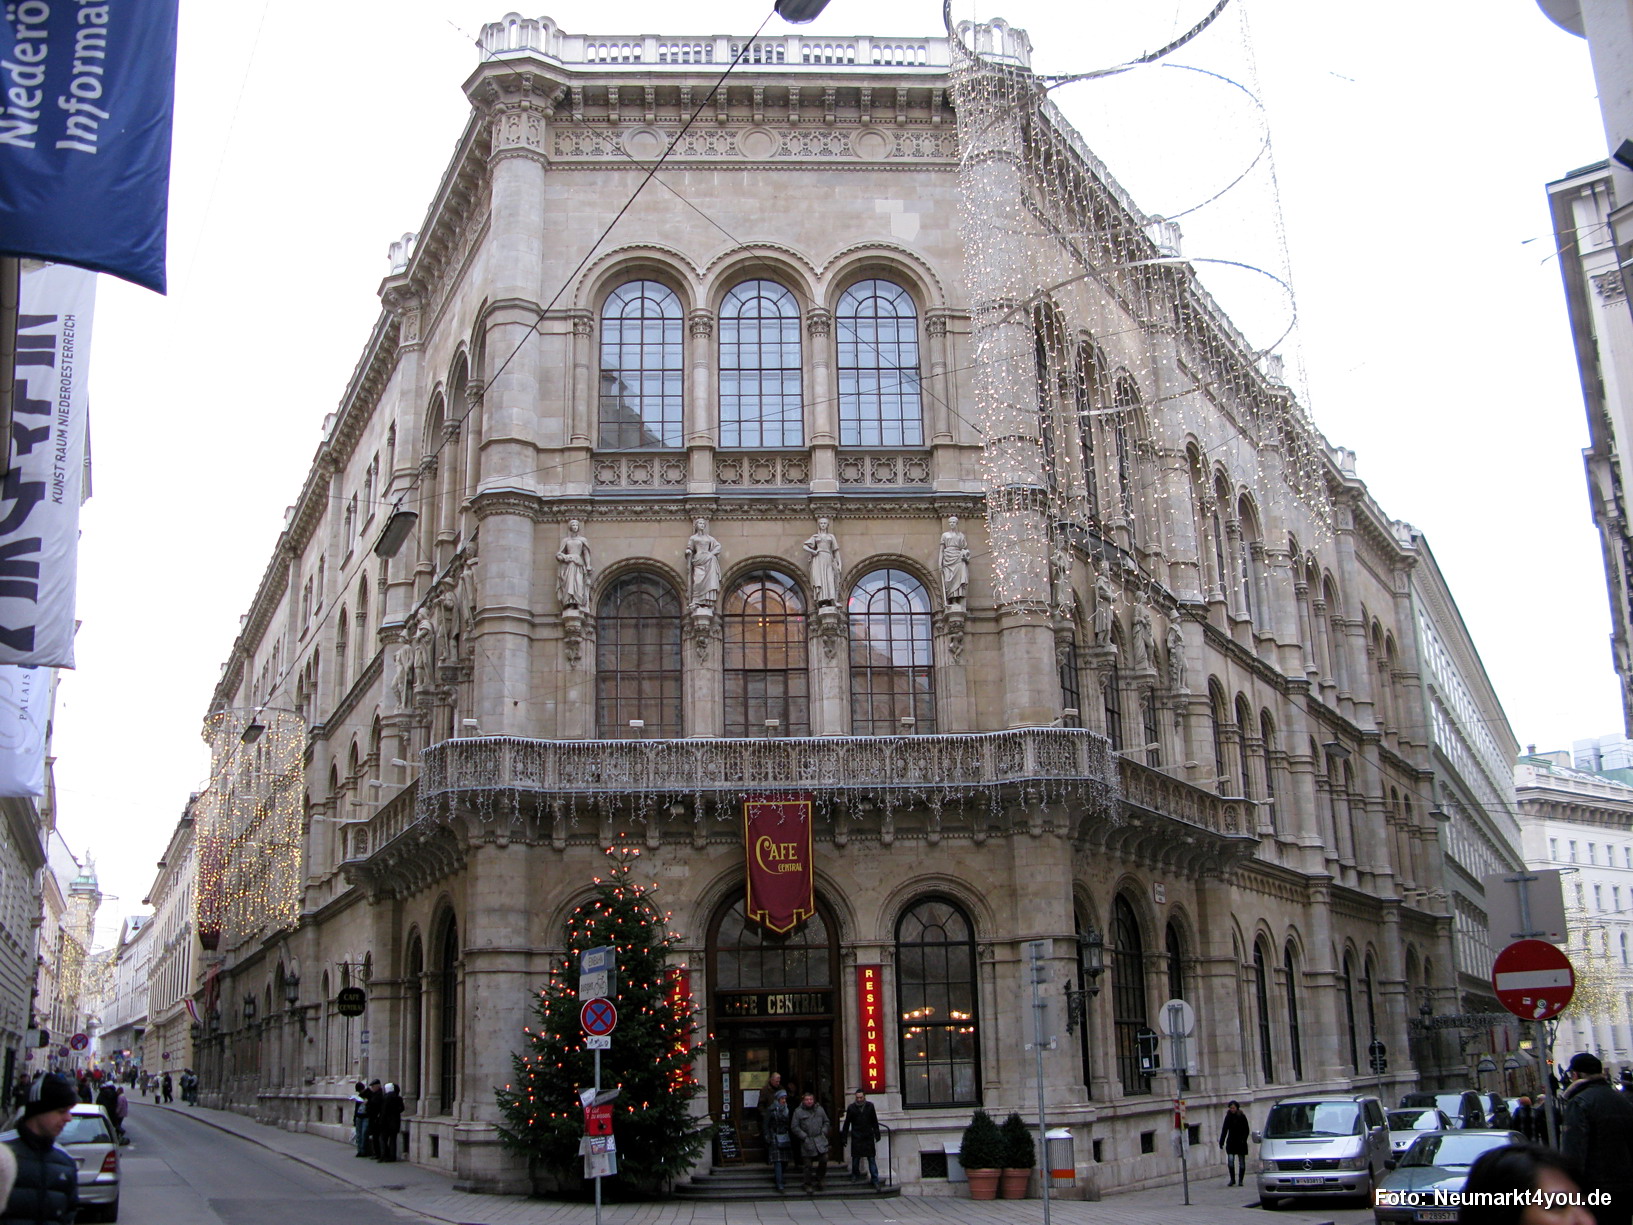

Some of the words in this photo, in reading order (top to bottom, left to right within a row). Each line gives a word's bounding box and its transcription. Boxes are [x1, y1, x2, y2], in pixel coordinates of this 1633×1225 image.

[58, 314, 76, 427] NIEDEROESTERREICH
[55, 430, 69, 463] RAUM
[51, 464, 66, 504] KUNST
[19, 673, 31, 720] PALAIS
[756, 836, 797, 874] CAFE
[778, 863, 802, 872] CENTRAL
[767, 993, 825, 1014] CENTRAL
[865, 969, 878, 1090] RESTAURANT
